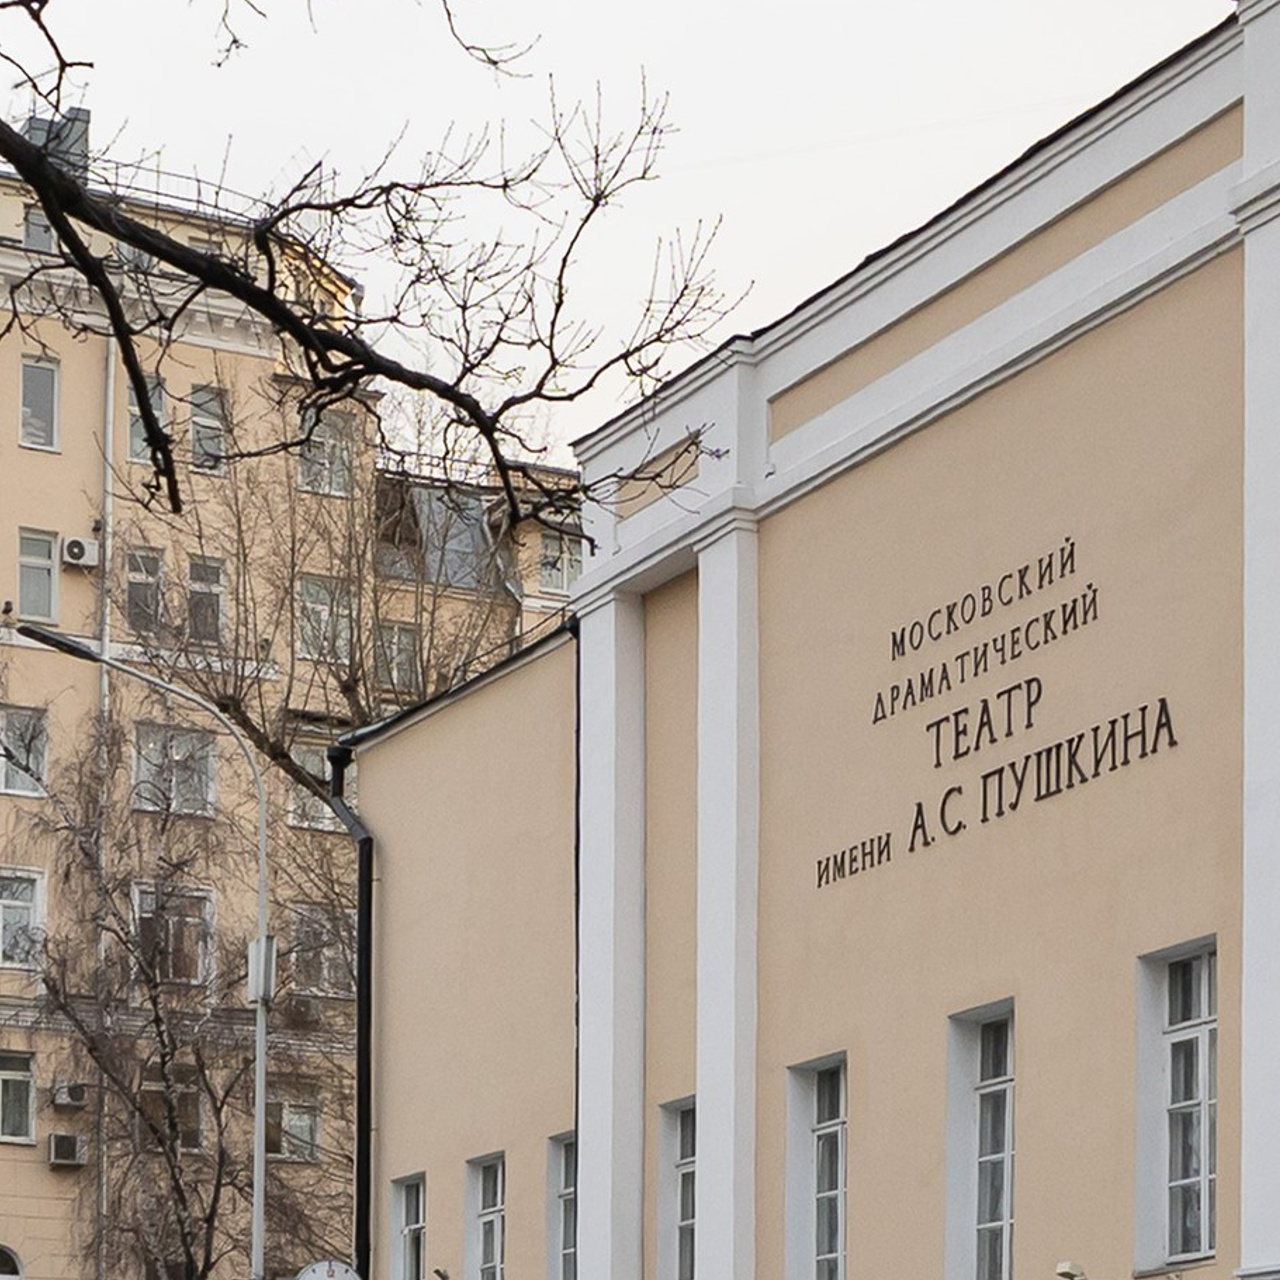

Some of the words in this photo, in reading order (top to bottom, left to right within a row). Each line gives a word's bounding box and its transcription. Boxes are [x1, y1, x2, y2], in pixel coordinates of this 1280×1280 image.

[872, 582, 1099, 725] ДРАМАТИЧЕСКИЙ
[890, 536, 1076, 661] МОСКОВСКИЙ
[926, 676, 1043, 768] ТЕАТР
[816, 832, 892, 889] ИМЕНИ
[980, 697, 1178, 823] ПУШКИНА
